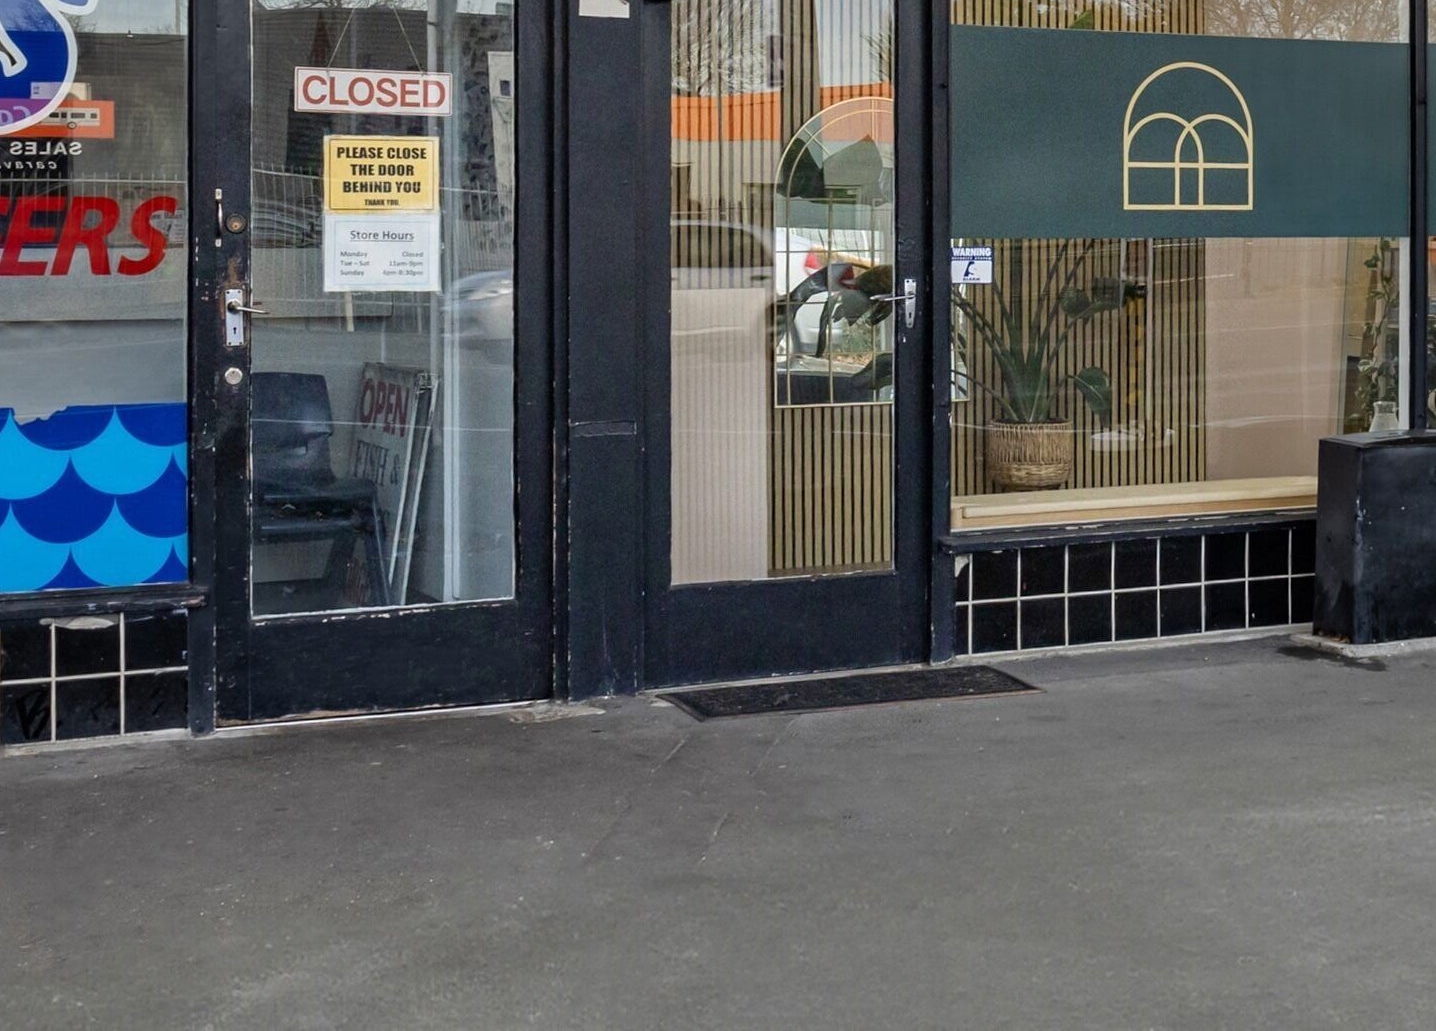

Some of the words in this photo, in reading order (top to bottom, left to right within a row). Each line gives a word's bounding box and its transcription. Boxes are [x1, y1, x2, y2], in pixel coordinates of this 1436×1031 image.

[302, 75, 446, 108] CLOSED
[336, 147, 383, 159] PLEASE
[387, 147, 427, 159] CLOSE
[350, 164, 375, 176] THE
[378, 164, 414, 176] DOOR
[342, 181, 392, 194] BEHIND
[395, 181, 421, 194] YOU
[0, 195, 179, 276] ERS
[350, 231, 379, 240] Store
[382, 231, 414, 240] Hours
[340, 251, 368, 259] Monday
[952, 247, 992, 257] WARNING
[359, 378, 410, 437] OPEN
